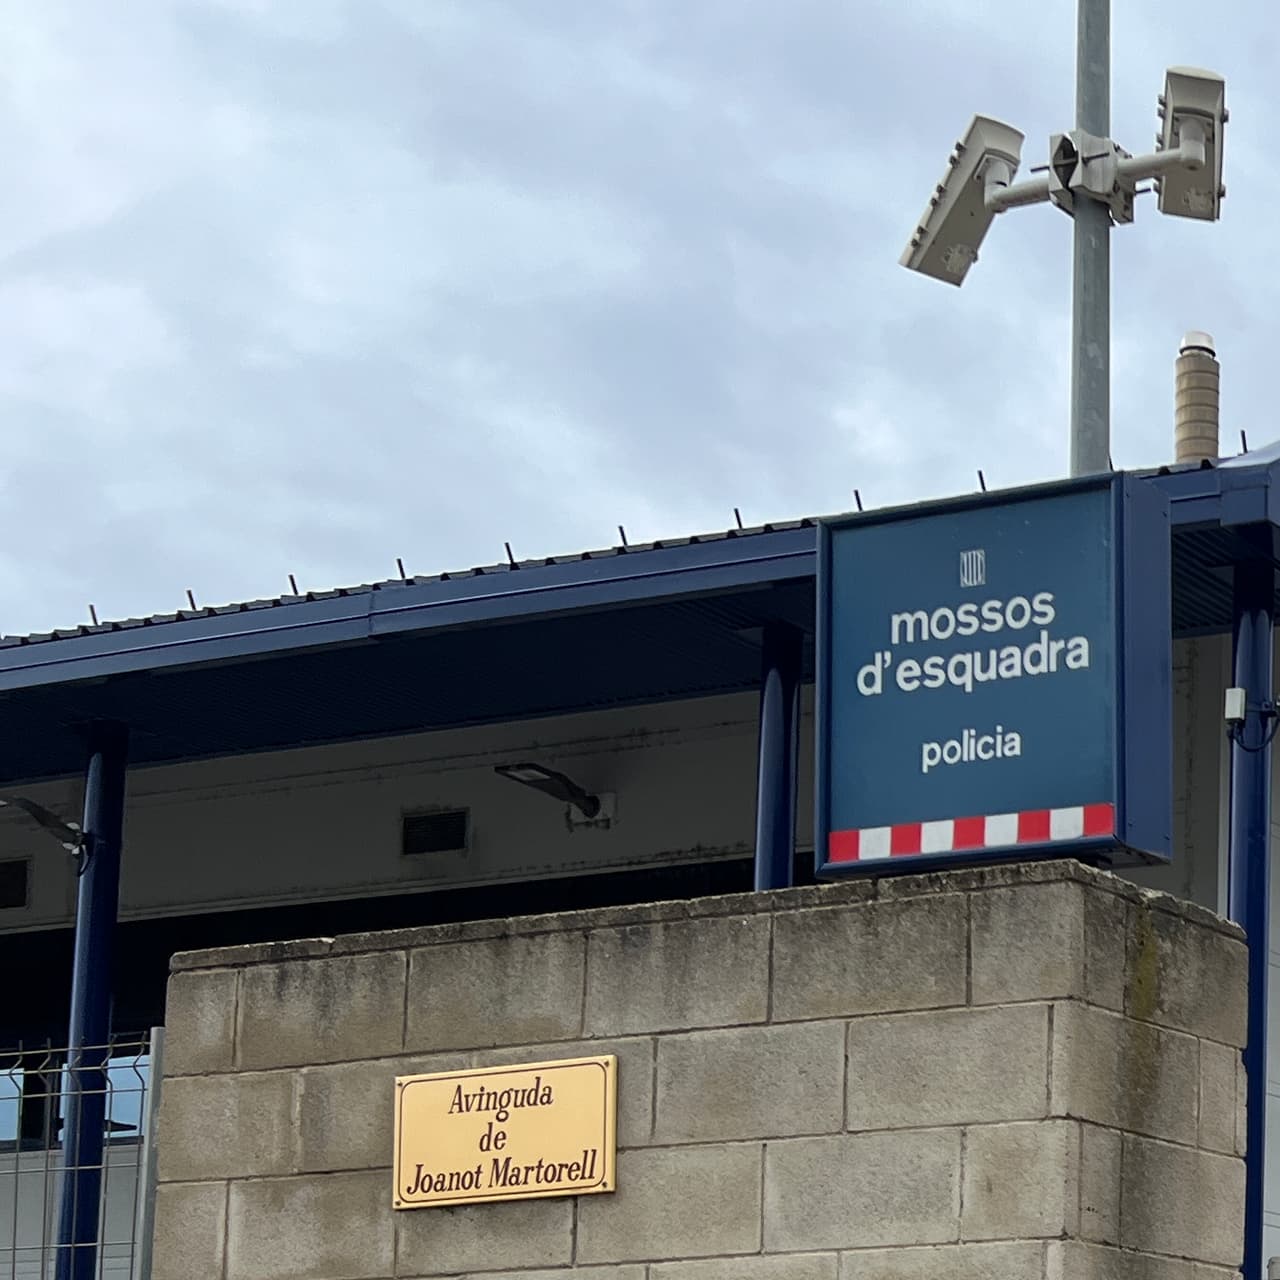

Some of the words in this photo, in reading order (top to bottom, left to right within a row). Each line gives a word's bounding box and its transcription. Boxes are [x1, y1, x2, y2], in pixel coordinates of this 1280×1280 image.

[891, 591, 1056, 644] mossos
[856, 630, 1090, 696] d'esquadra
[921, 725, 1021, 773] policia
[448, 1076, 554, 1122] Avinguda
[479, 1122, 507, 1152] de
[407, 1163, 482, 1195] Joanot
[488, 1149, 598, 1188] Martorell
